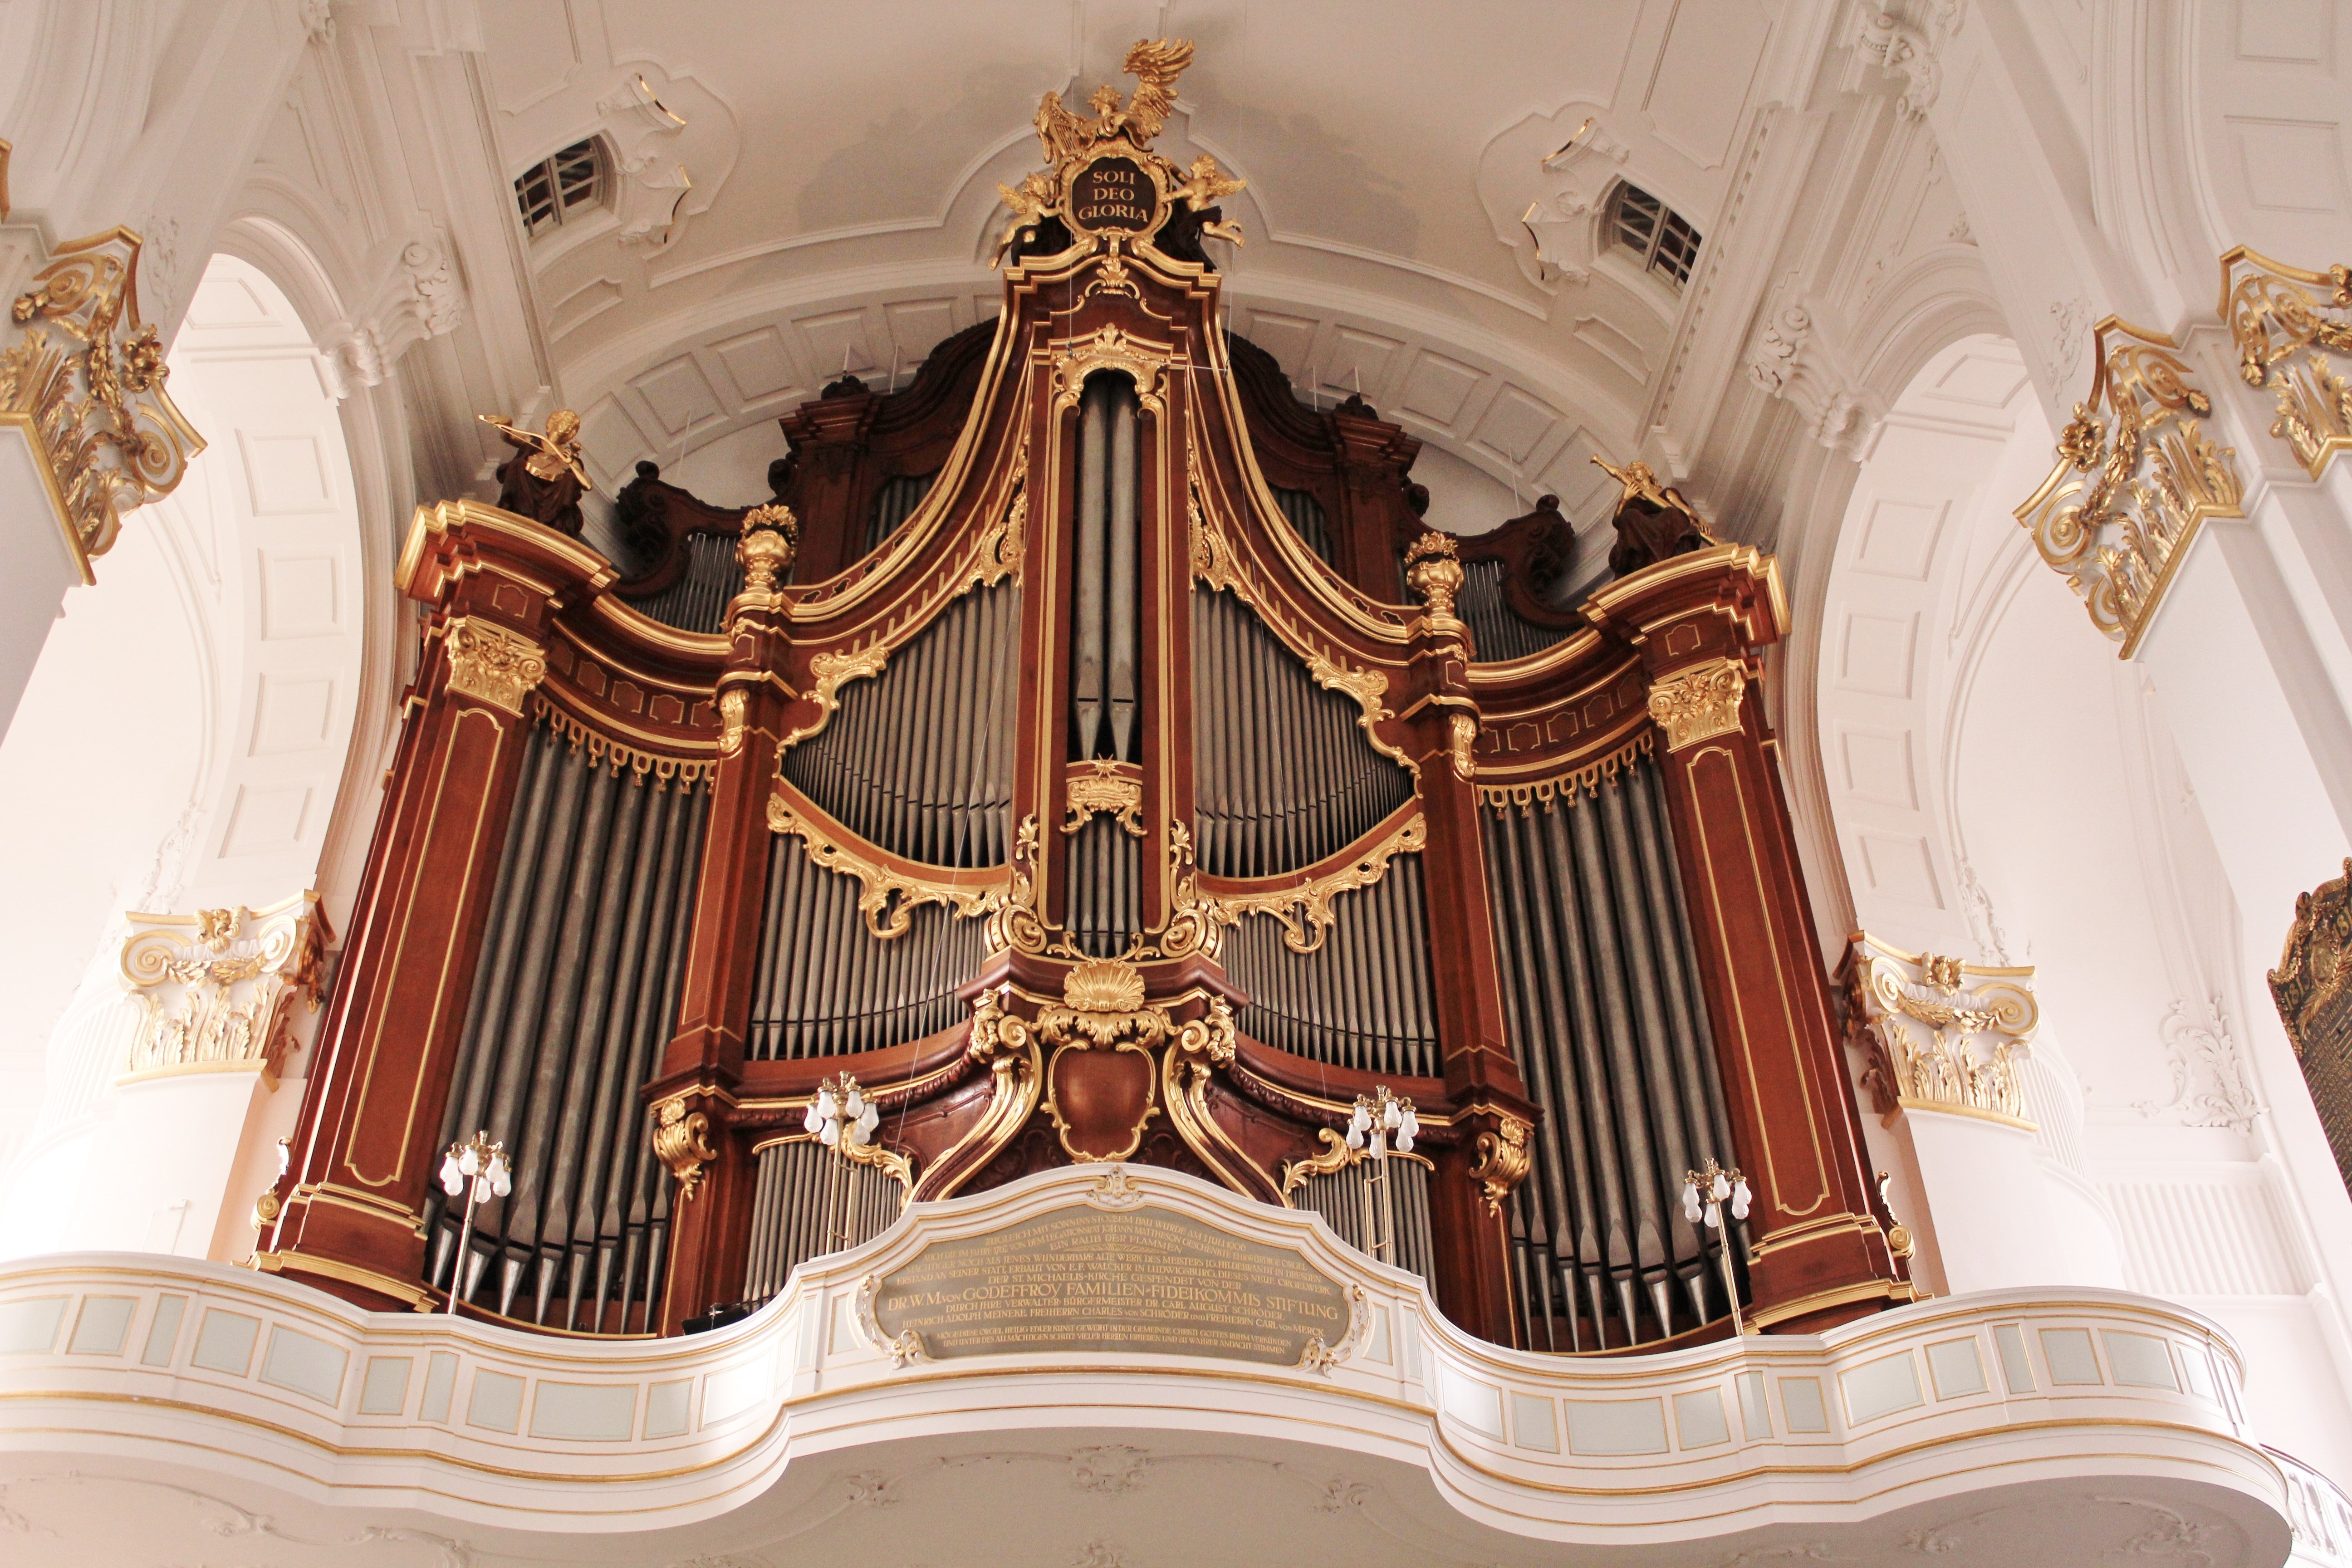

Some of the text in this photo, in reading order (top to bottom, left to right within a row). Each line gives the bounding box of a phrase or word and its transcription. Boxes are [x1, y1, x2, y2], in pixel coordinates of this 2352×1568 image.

[1093, 171, 1135, 185] SOLI
[1093, 187, 1135, 201] DEO
[1078, 204, 1149, 223] GLORIA
[923, 1253, 943, 1262] AUCH
[959, 1249, 969, 1257] IM
[970, 1247, 993, 1258] JAHRE
[1010, 1241, 1026, 1250] VON
[1028, 1236, 1045, 1246] DEM
[1046, 1226, 1100, 1242] LEGATIONSRAT
[1101, 1225, 1133, 1234] JOHANN
[1135, 1226, 1183, 1243] MATTHESON
[1182, 1238, 1231, 1258] GESCHENKTE
[985, 1228, 1030, 1246] ZUGLEICH
[1032, 1225, 1049, 1236] MIT
[1050, 1216, 1090, 1229] SONNINS
[1135, 1217, 1153, 1227] BAU
[1155, 1220, 1186, 1235] WURDE
[1188, 1230, 1203, 1239] AM
[1207, 1235, 1225, 1247] JULI
[1226, 1240, 1247, 1251] 1906
[1050, 1234, 1183, 1254] EIN RAUB DER FLAMMEN
[897, 1273, 933, 1286] ERSTAND
[949, 1267, 980, 1278] SEINER
[1009, 1264, 1043, 1273] ERBAUT
[1046, 1263, 1067, 1272] VON
[1087, 1262, 1132, 1272] WALCKER
[1135, 1264, 1145, 1273] IN
[1218, 1271, 1249, 1281] DIESES
[1251, 1274, 1275, 1285] NEUE
[959, 1257, 984, 1268] NOCH
[985, 1256, 1000, 1265] ALS
[1003, 1254, 1031, 1264] JENES
[1034, 1253, 1094, 1262] WUNDERBARE
[1096, 1253, 1115, 1261] ALTE
[1117, 1253, 1142, 1262] WERK
[1144, 1254, 1161, 1263] DES
[1162, 1255, 1204, 1266] MEISTERS
[1275, 1268, 1284, 1276] IN
[1286, 1271, 1323, 1283] DRESDEN
[988, 1275, 1009, 1284] DER
[1026, 1272, 1128, 1282] MICHAELIS-KIRCHE
[1131, 1273, 1195, 1286] GESPENDET
[1197, 1278, 1220, 1288] VON
[1221, 1280, 1242, 1290] DER
[941, 1294, 962, 1303] VON
[963, 1283, 1063, 1301] GODEFFROY
[1266, 1296, 1339, 1320] STIFTUNG
[946, 1302, 980, 1313] DURCH
[1063, 1295, 1142, 1307] BÜRGERMEISTER
[1161, 1300, 1186, 1310] CARL
[1188, 1302, 1228, 1313] AUGUST
[902, 1315, 943, 1329] HEINRICH
[945, 1311, 981, 1322] ADOLPH
[1030, 1307, 1079, 1317] FREIHERRN
[1082, 1307, 1123, 1316] CHARLES
[1206, 1313, 1254, 1326] FREIHERRN
[1255, 1318, 1278, 1329] CARL
[936, 1332, 959, 1340] MÖGE
[1132, 1325, 1172, 1334] GEMEINDE
[1172, 1328, 1198, 1336] CHRISTI
[1200, 1330, 1229, 1338] GOTTES
[1229, 1332, 1250, 1341] RUHM
[1250, 1334, 1292, 1347] VERKÜNDEN
[943, 1339, 957, 1347] UND
[959, 1337, 981, 1346] UNTER
[996, 1333, 1048, 1342] ALLMÄCHTIGEN
[1077, 1332, 1101, 1340] VIELER
[1102, 1332, 1129, 1340] HERZEN
[1129, 1333, 1161, 1342] ERHEBEN
[1188, 1337, 1219, 1346] WAHRER
[1219, 1339, 1251, 1350] ANDACHT
[1253, 1343, 1285, 1354] STIMMEN
